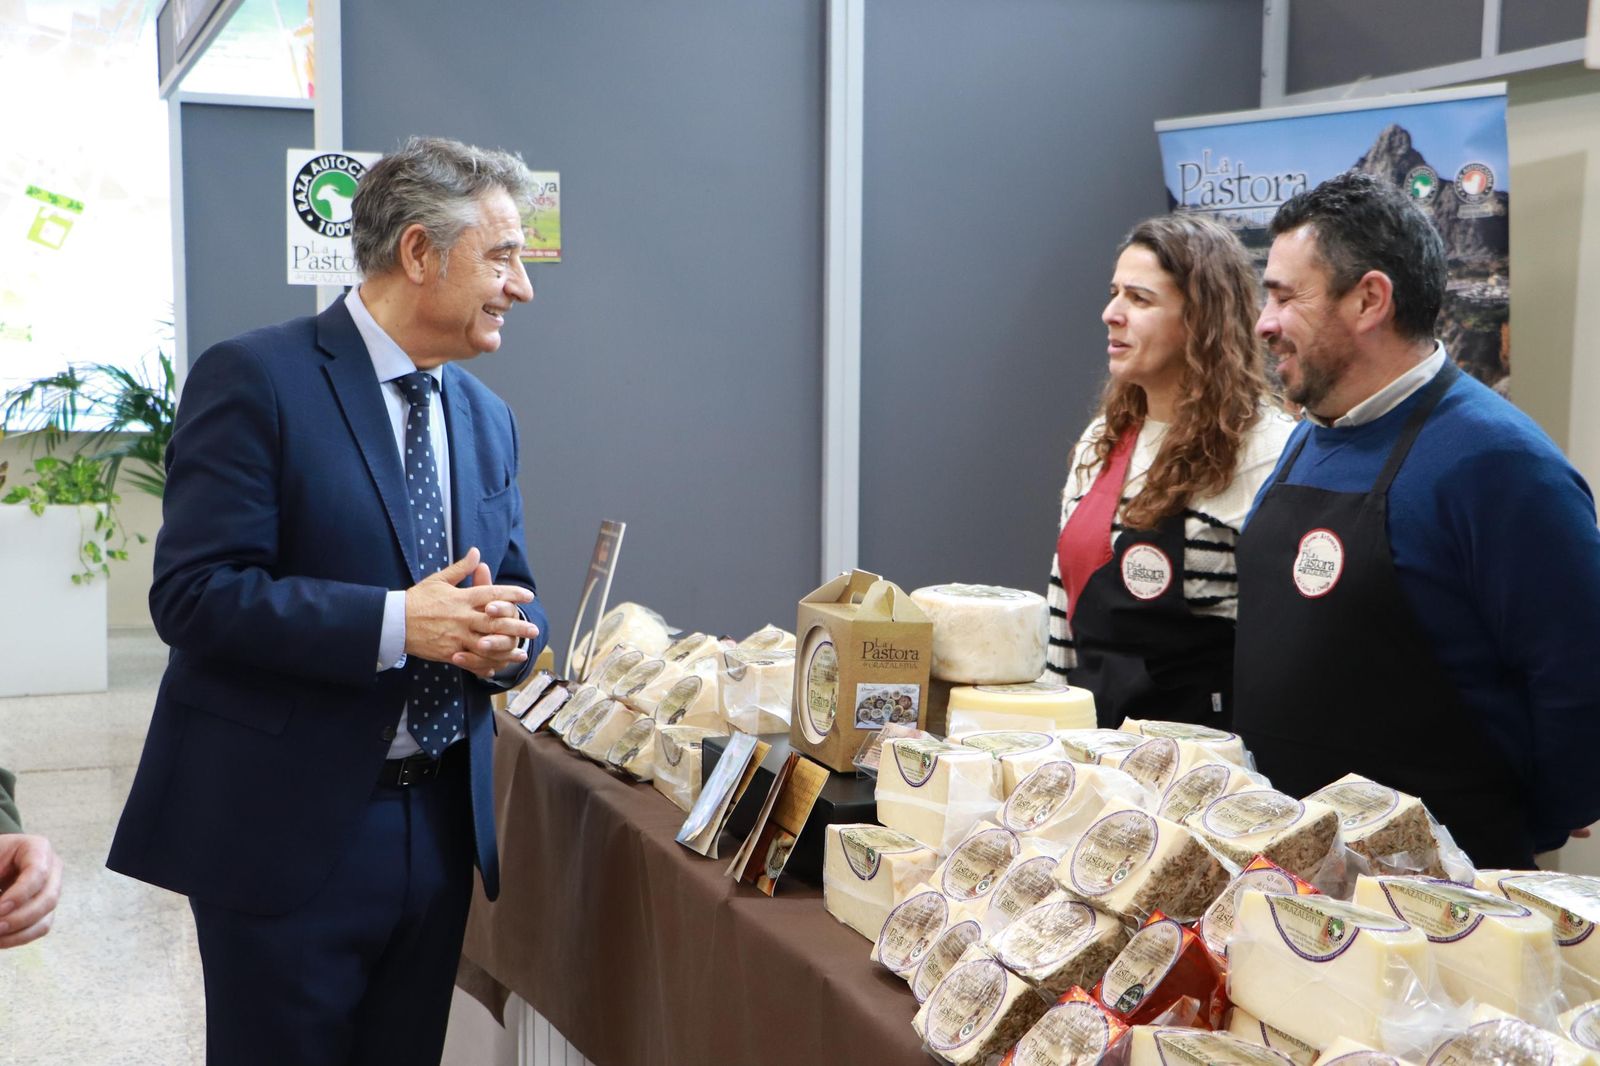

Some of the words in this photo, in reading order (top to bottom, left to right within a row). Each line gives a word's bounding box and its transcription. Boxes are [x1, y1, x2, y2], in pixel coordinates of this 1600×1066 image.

[1203, 150, 1229, 175] La
[297, 174, 313, 212] RAZA
[1179, 162, 1307, 207] Pastora
[312, 240, 329, 254] La
[1126, 561, 1164, 580] Pastora
[1299, 552, 1335, 571] Pastora
[861, 641, 919, 660] Pastora
[875, 637, 887, 648] La
